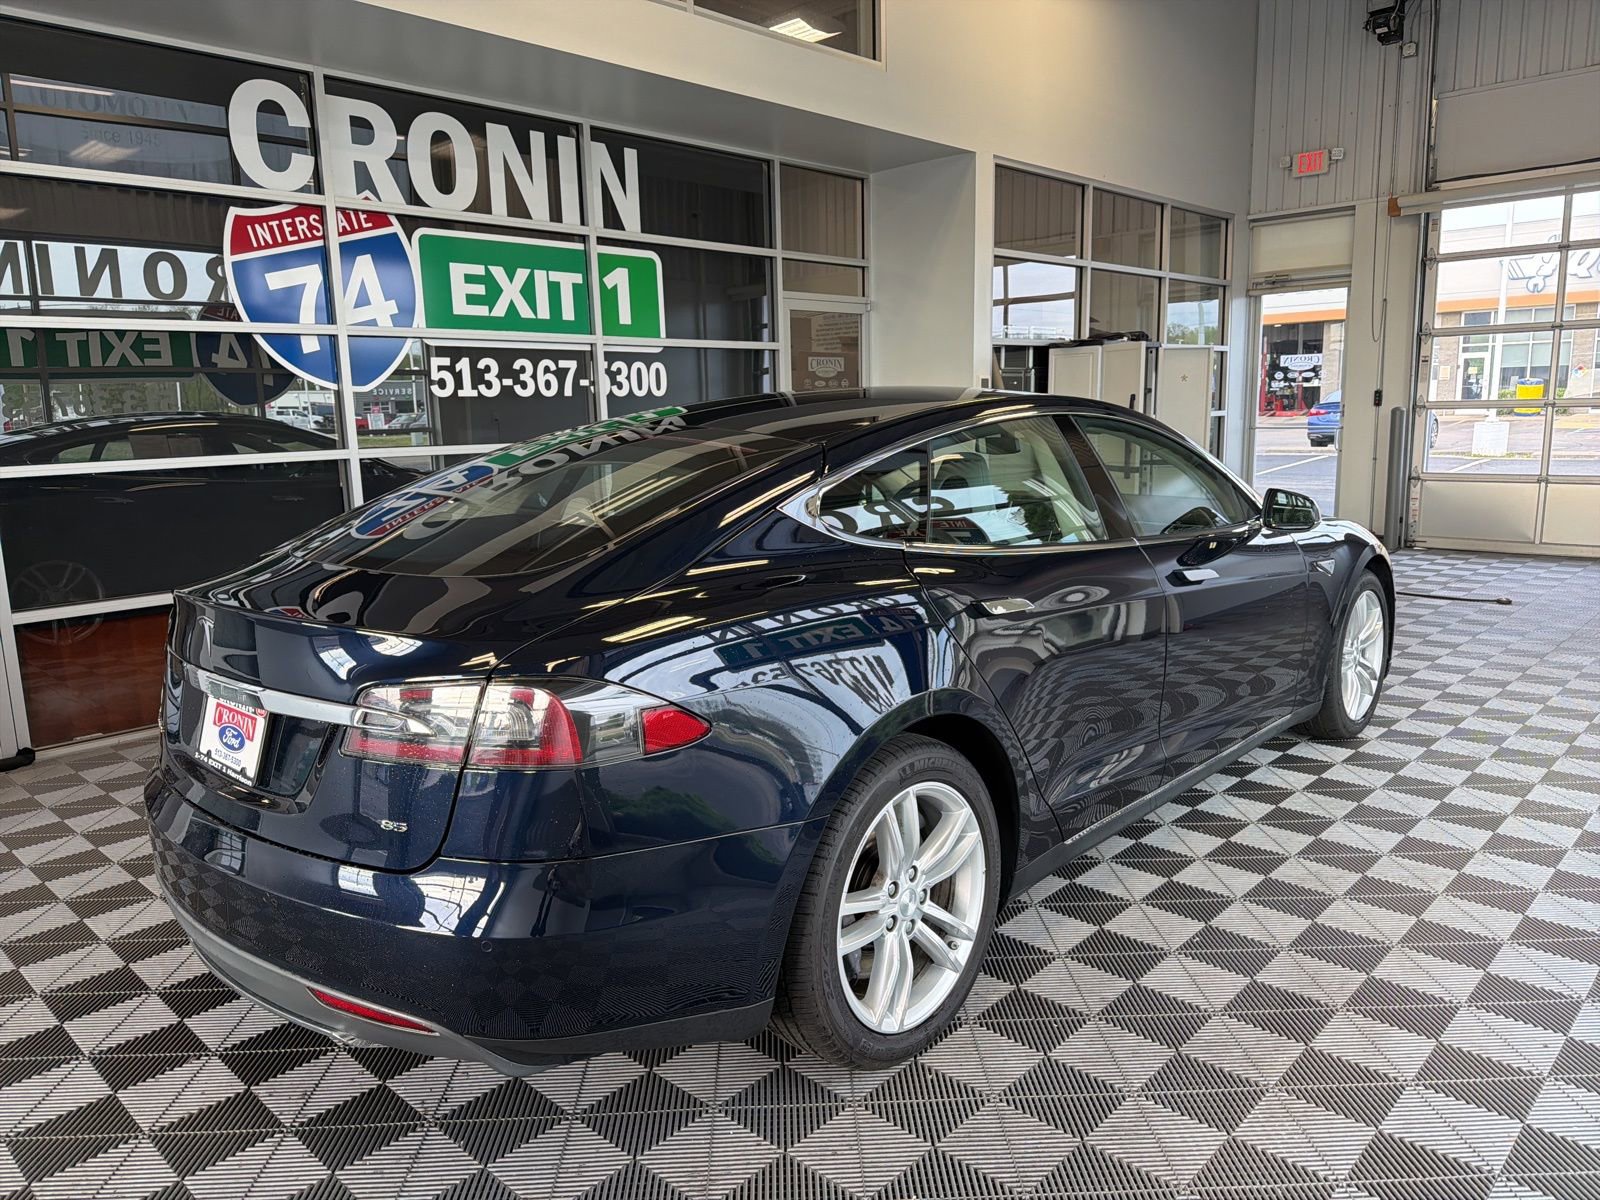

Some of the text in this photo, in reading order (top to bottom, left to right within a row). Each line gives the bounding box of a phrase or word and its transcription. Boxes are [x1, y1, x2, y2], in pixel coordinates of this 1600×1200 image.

[228, 79, 642, 234] CRONIN
[1297, 151, 1324, 174] EXIT
[246, 209, 373, 249] INTERSATE
[264, 252, 398, 355] 74
[448, 261, 633, 326] EXIT 1
[810, 358, 843, 371] CRONIN
[215, 706, 255, 740] CRONIN
[222, 727, 242, 749] Ford
[208, 759, 222, 771] EXIT
[227, 769, 253, 787] Harrison
[380, 819, 409, 833] 85
